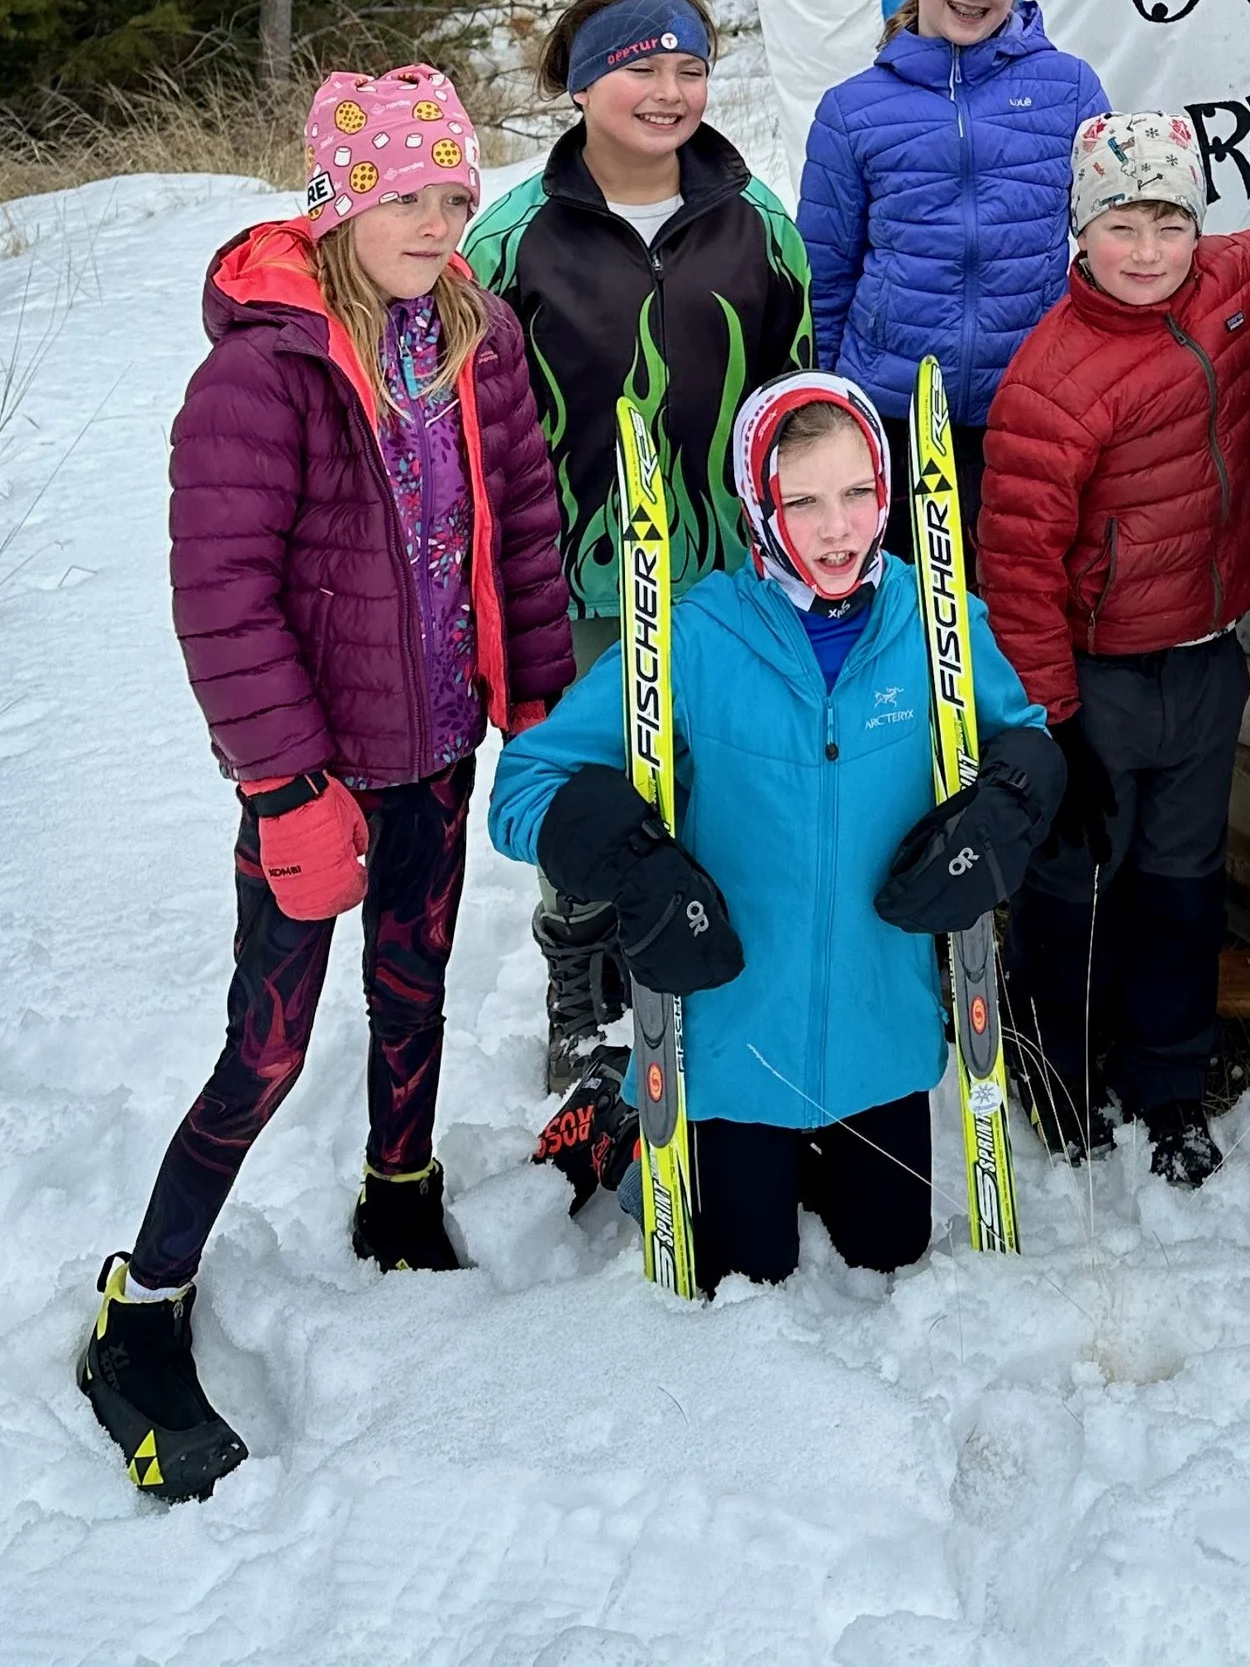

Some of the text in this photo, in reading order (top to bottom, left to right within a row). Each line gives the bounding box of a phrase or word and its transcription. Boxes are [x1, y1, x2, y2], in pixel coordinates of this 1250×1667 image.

[307, 178, 328, 206] RE
[926, 499, 966, 709] FISCHER
[634, 545, 661, 768] FISCHER
[948, 847, 980, 876] OR
[686, 900, 709, 938] OR
[652, 1179, 675, 1247] SPRINT
